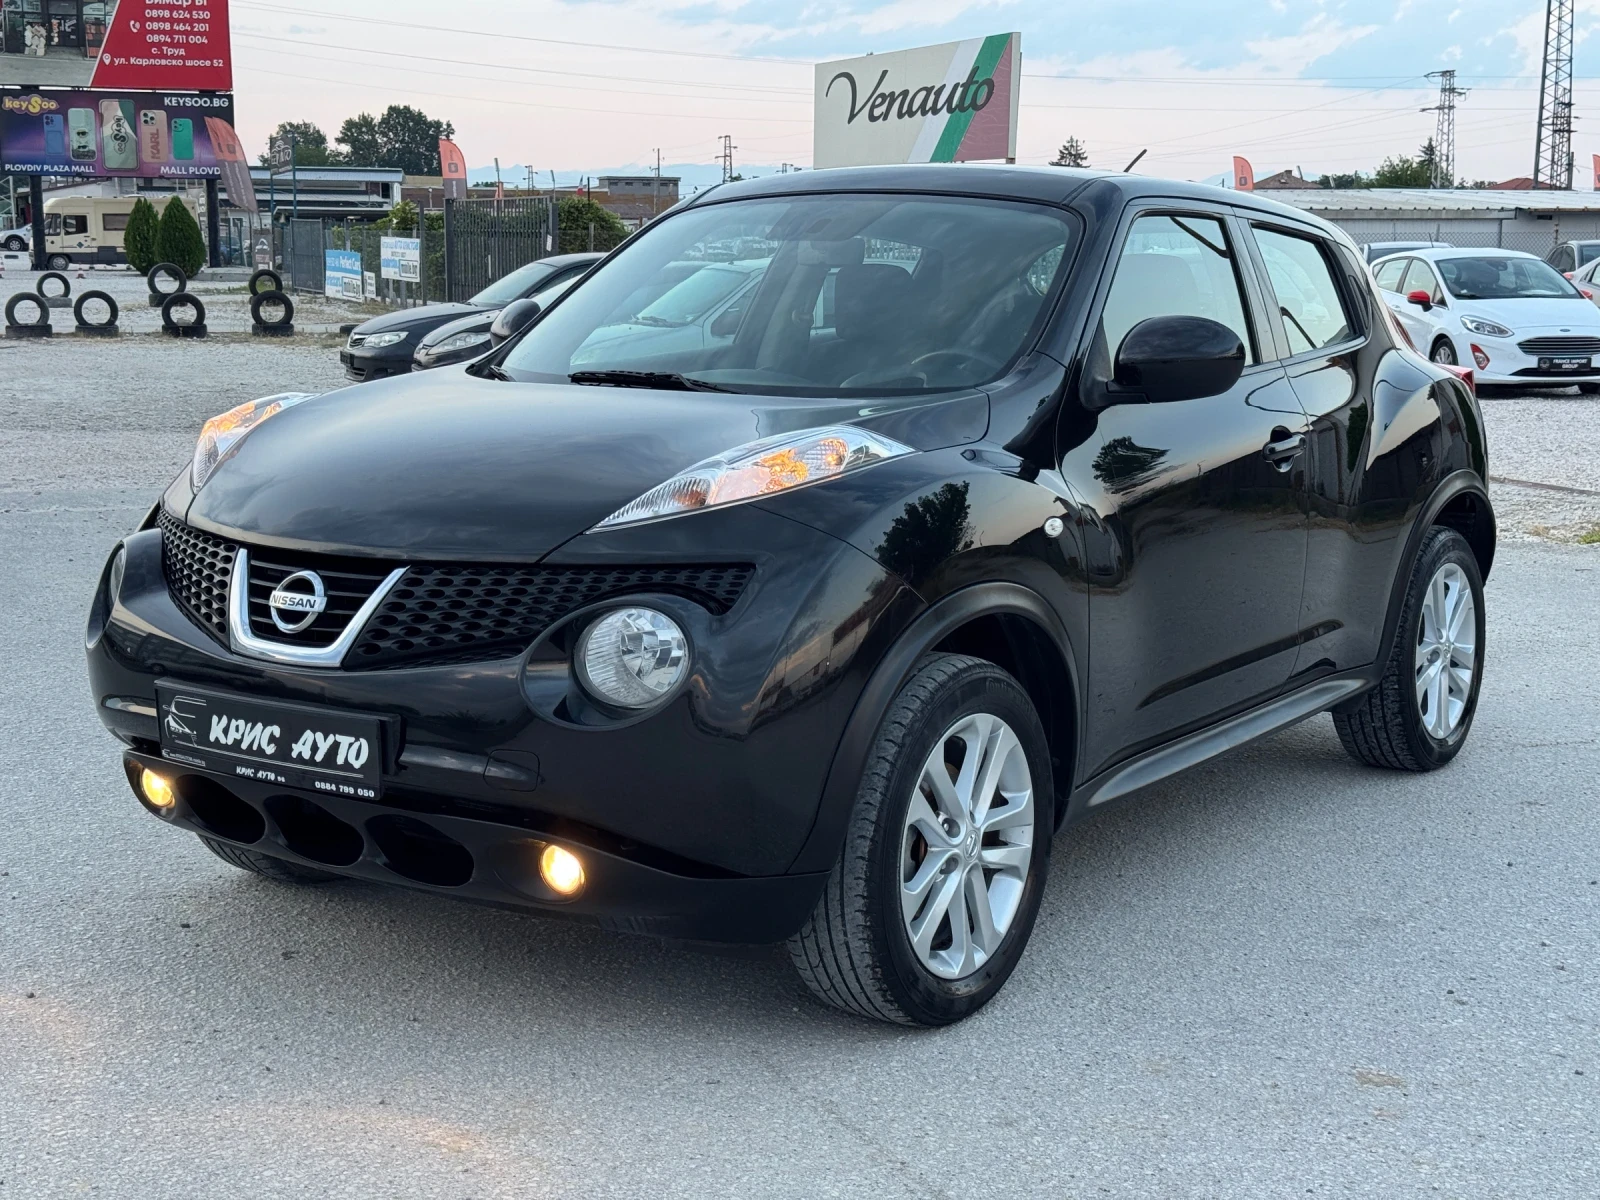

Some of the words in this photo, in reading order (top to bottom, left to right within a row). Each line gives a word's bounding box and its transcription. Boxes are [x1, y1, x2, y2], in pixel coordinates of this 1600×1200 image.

[145, 9, 171, 18] 0898
[172, 10, 190, 19] 624
[192, 10, 211, 19] 530
[145, 21, 171, 31] 0898
[173, 22, 191, 31] 464
[193, 23, 210, 32] 201
[146, 34, 171, 43] 0894
[173, 35, 187, 43] 711
[188, 35, 208, 44] 004
[162, 46, 186, 56] Труд
[113, 57, 129, 66] ул.
[130, 57, 184, 66] Карловско
[185, 59, 211, 67] шосе
[213, 59, 224, 67] 52
[825, 65, 995, 125] Venauto
[5, 96, 57, 113] keySoo
[164, 96, 229, 108] KEYSOO.BG
[150, 128, 160, 160] KARL
[71, 165, 95, 173] MALL
[160, 166, 187, 174] MALL
[189, 166, 221, 175] PLOVD
[270, 594, 317, 609] NISSAN
[208, 714, 281, 755] КРИС
[291, 729, 369, 769] АУТО
[235, 765, 255, 777] КРИС
[256, 769, 276, 781] АУТО
[314, 781, 336, 791] 0884
[357, 787, 375, 798] 050
